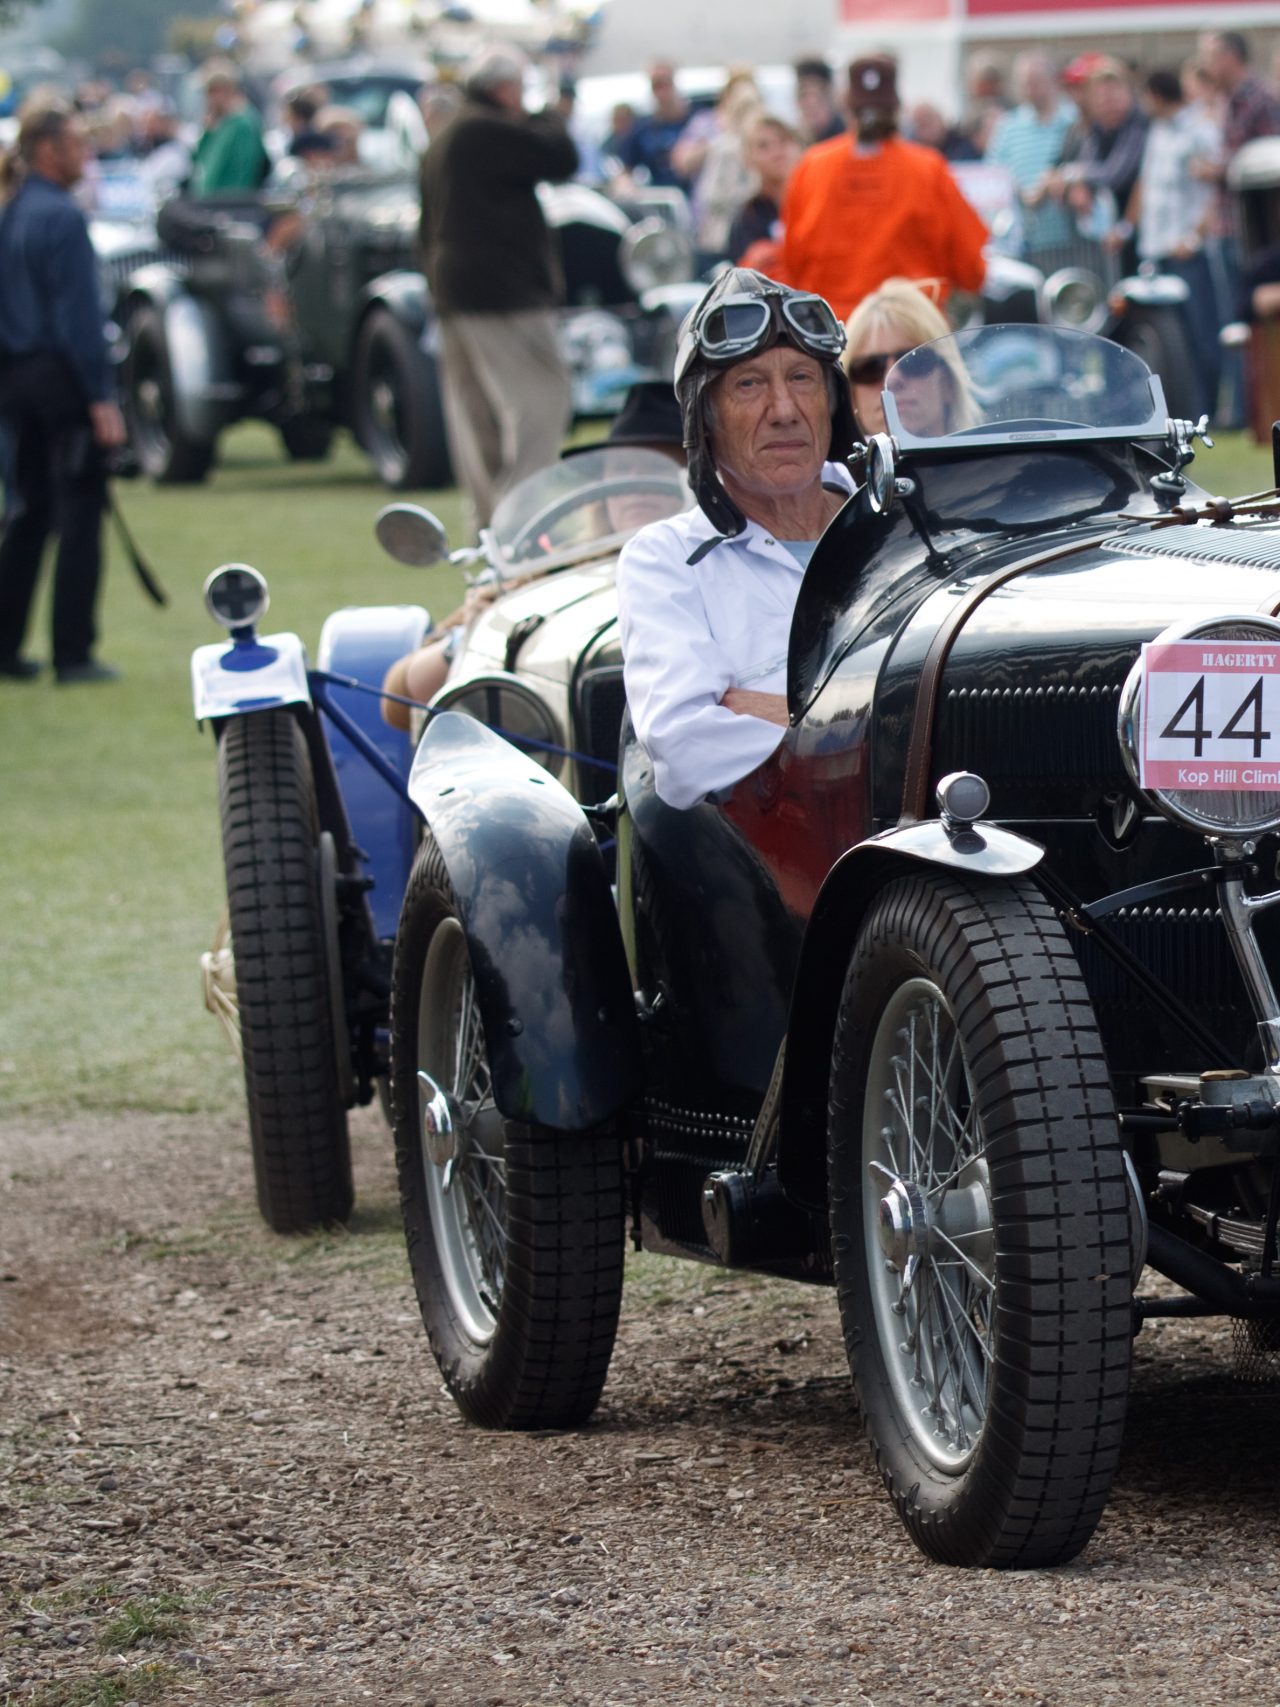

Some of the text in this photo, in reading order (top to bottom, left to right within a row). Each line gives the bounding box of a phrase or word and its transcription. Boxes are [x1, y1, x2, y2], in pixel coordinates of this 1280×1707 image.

[1202, 653, 1277, 667] HAGERTY
[1178, 769, 1209, 785] Kop
[1213, 769, 1237, 784] Hill
